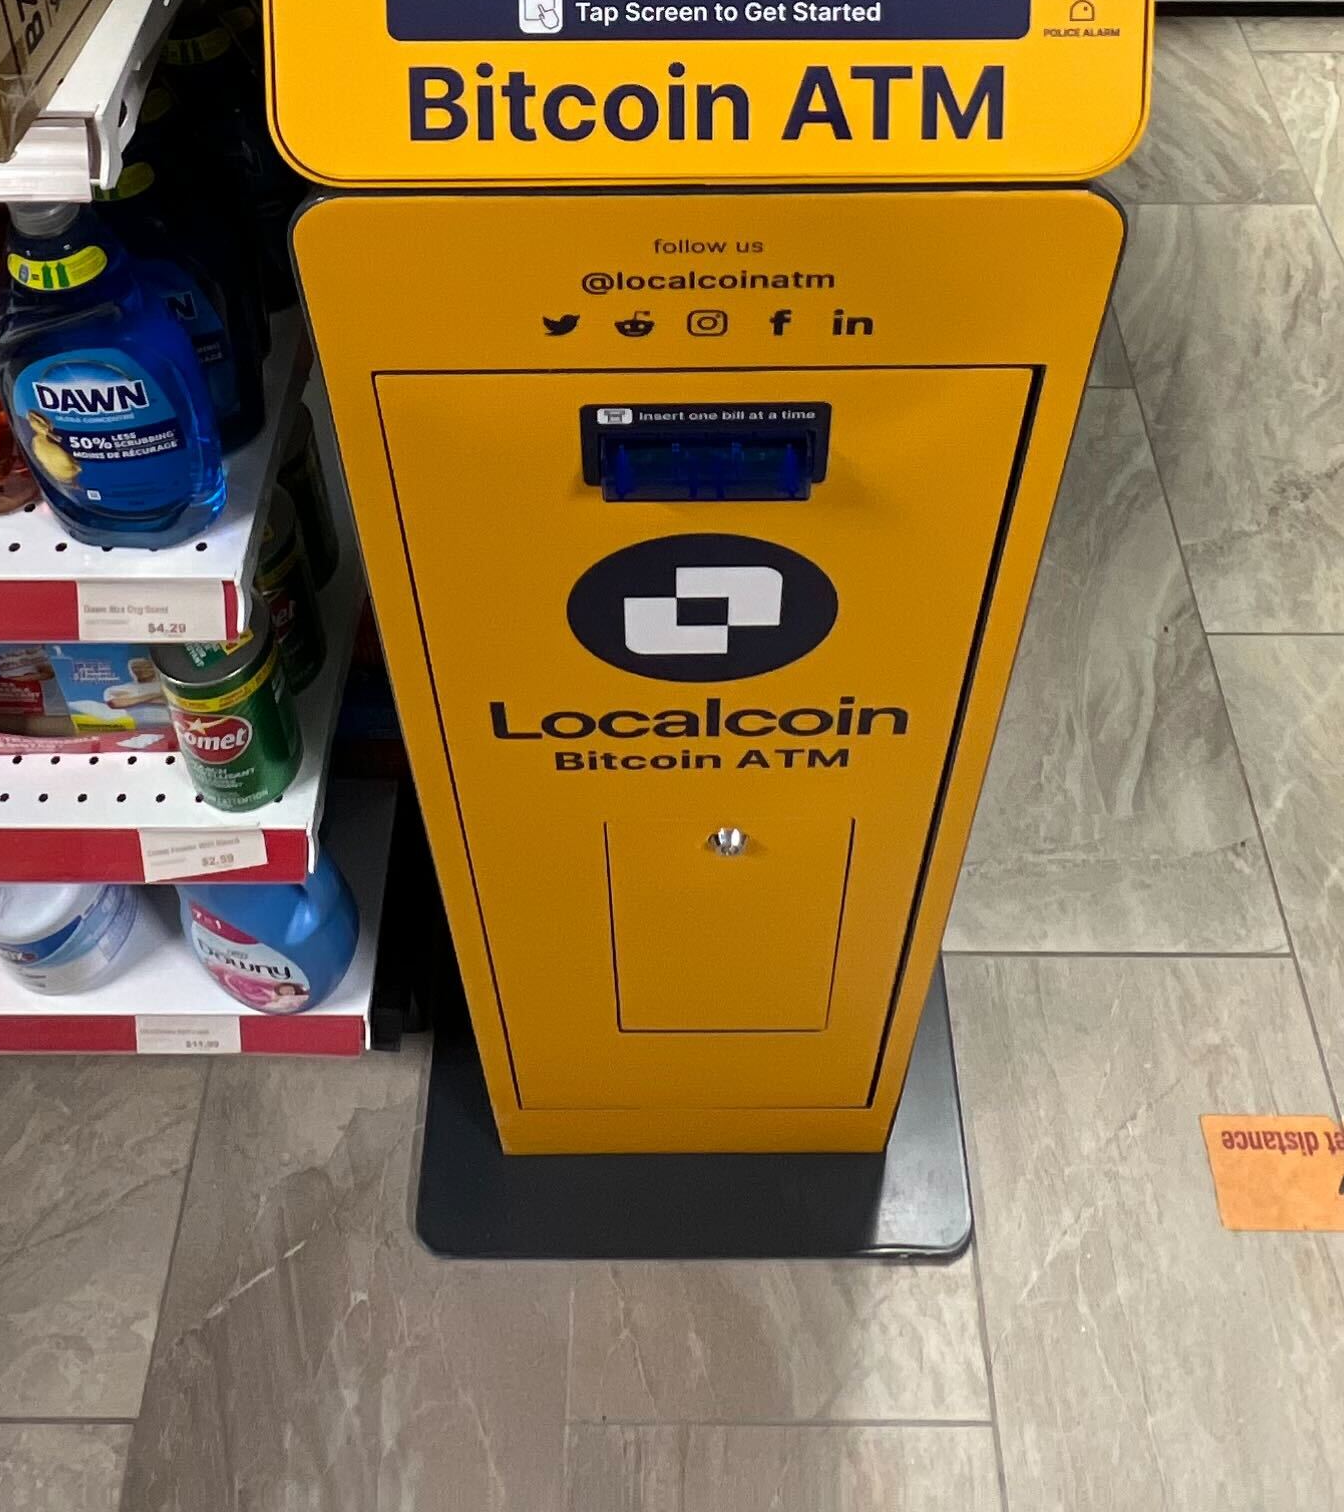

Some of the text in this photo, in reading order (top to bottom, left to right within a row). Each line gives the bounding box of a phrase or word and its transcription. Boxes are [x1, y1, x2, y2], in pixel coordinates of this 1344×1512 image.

[575, 1, 882, 26] Tap Screen to Get Started
[1043, 28, 1120, 38] POLICE ALARM
[408, 61, 1006, 142] Bitcoin ATM
[654, 238, 764, 255] follow us
[581, 270, 836, 295] @localcoinatm
[38, 381, 149, 413] DAWN
[638, 410, 685, 422] Insert
[689, 412, 718, 422] one
[721, 410, 745, 421] bill
[749, 411, 765, 421] at
[781, 409, 816, 421] time
[69, 435, 112, 450] 50%
[148, 622, 187, 635] $4.29
[489, 696, 909, 740] Localcoin
[554, 748, 850, 772] Bitcoin ATM
[1221, 1128, 1322, 1154] distance
